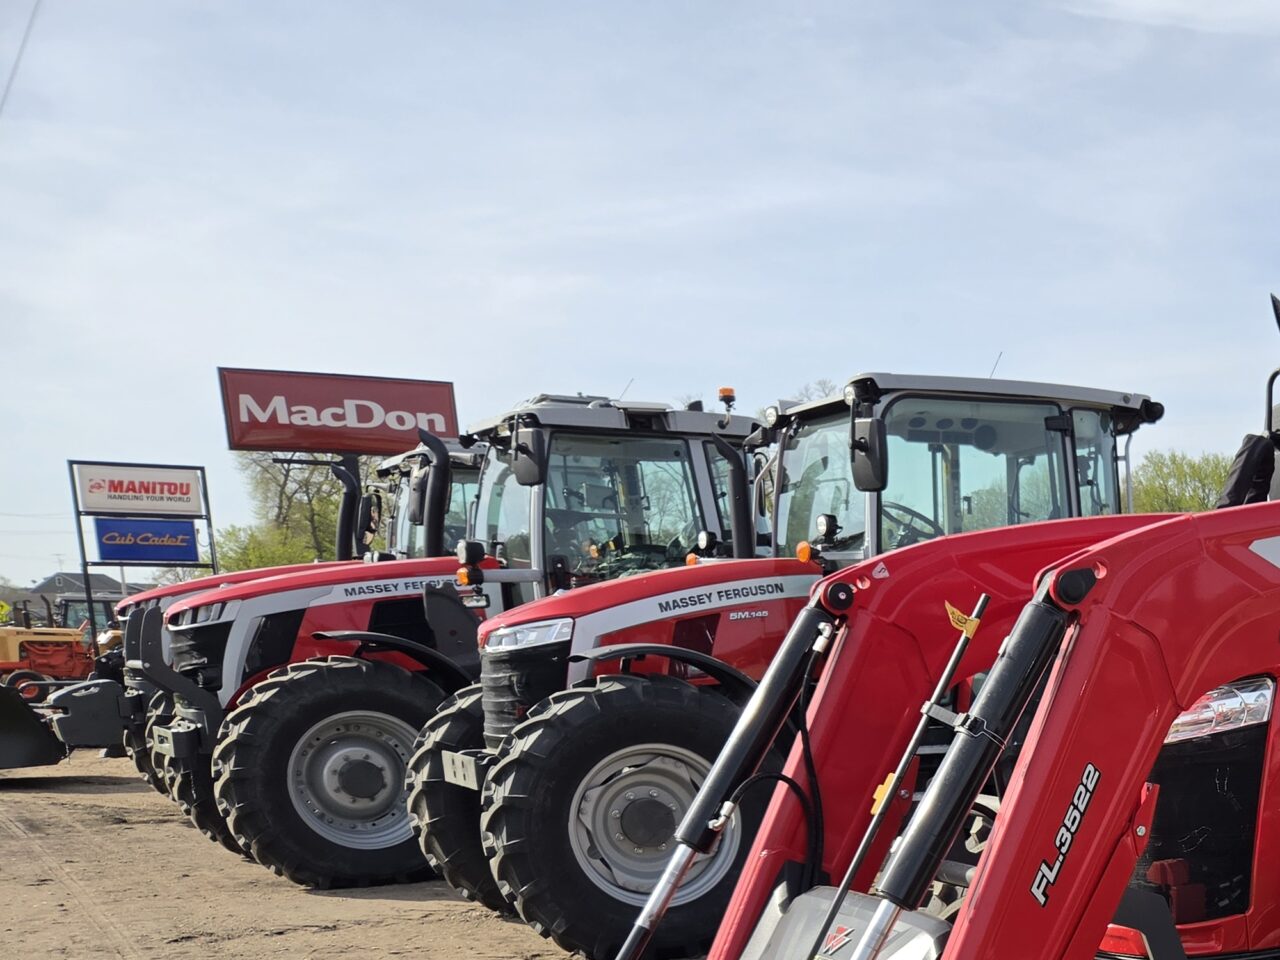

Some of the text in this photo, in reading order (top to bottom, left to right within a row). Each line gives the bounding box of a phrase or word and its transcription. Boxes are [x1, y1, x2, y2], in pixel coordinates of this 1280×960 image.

[239, 393, 447, 433] MacDon
[107, 479, 191, 496] MANITOU
[107, 494, 191, 504] HANDLING YOUR WORLD
[102, 532, 191, 547] Cub Cadet
[344, 582, 399, 598] MASSEY
[657, 582, 786, 613] MASSEY FERGUSON
[729, 610, 769, 620] 5M.145
[1029, 761, 1101, 907] FL.3522
